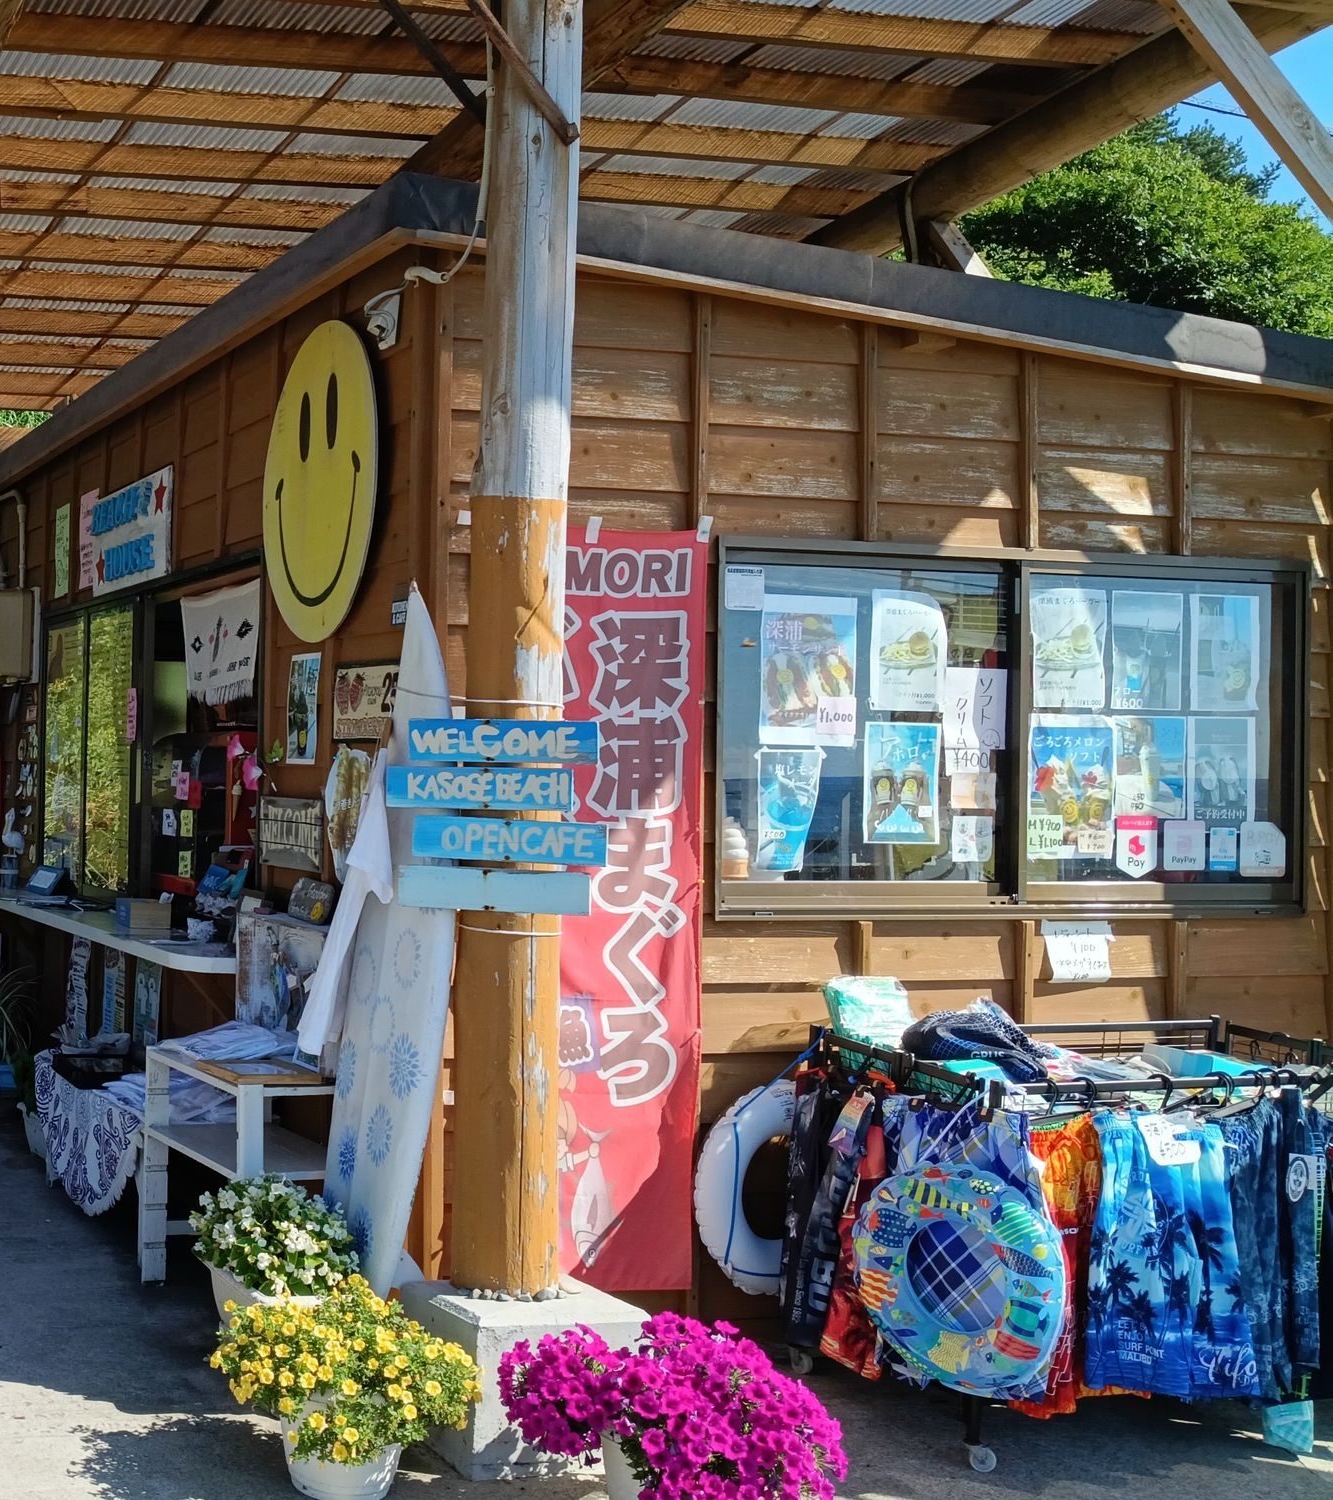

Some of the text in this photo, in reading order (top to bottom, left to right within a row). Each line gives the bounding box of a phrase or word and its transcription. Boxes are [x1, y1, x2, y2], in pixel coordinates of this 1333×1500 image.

[104, 534, 155, 582] HOUSE
[766, 619, 803, 642] 深浦
[980, 677, 994, 726] ソフト
[956, 697, 968, 748] クリーム
[411, 725, 580, 759] WELCOME
[1033, 735, 1105, 748] ごろごろメロン
[954, 749, 989, 770] ¥400
[407, 771, 569, 806] KASOSE BEACH
[260, 797, 320, 866] WELCOME
[1039, 818, 1061, 831] ¥900
[441, 824, 597, 859] OPEN CAFE
[1029, 837, 1037, 847] L
[586, 610, 690, 1108] 深浦まぐろ
[1127, 856, 1146, 870] Pay
[1171, 855, 1197, 865] PayPay
[795, 1289, 805, 1305] Since
[1118, 1341, 1143, 1351] SURF
